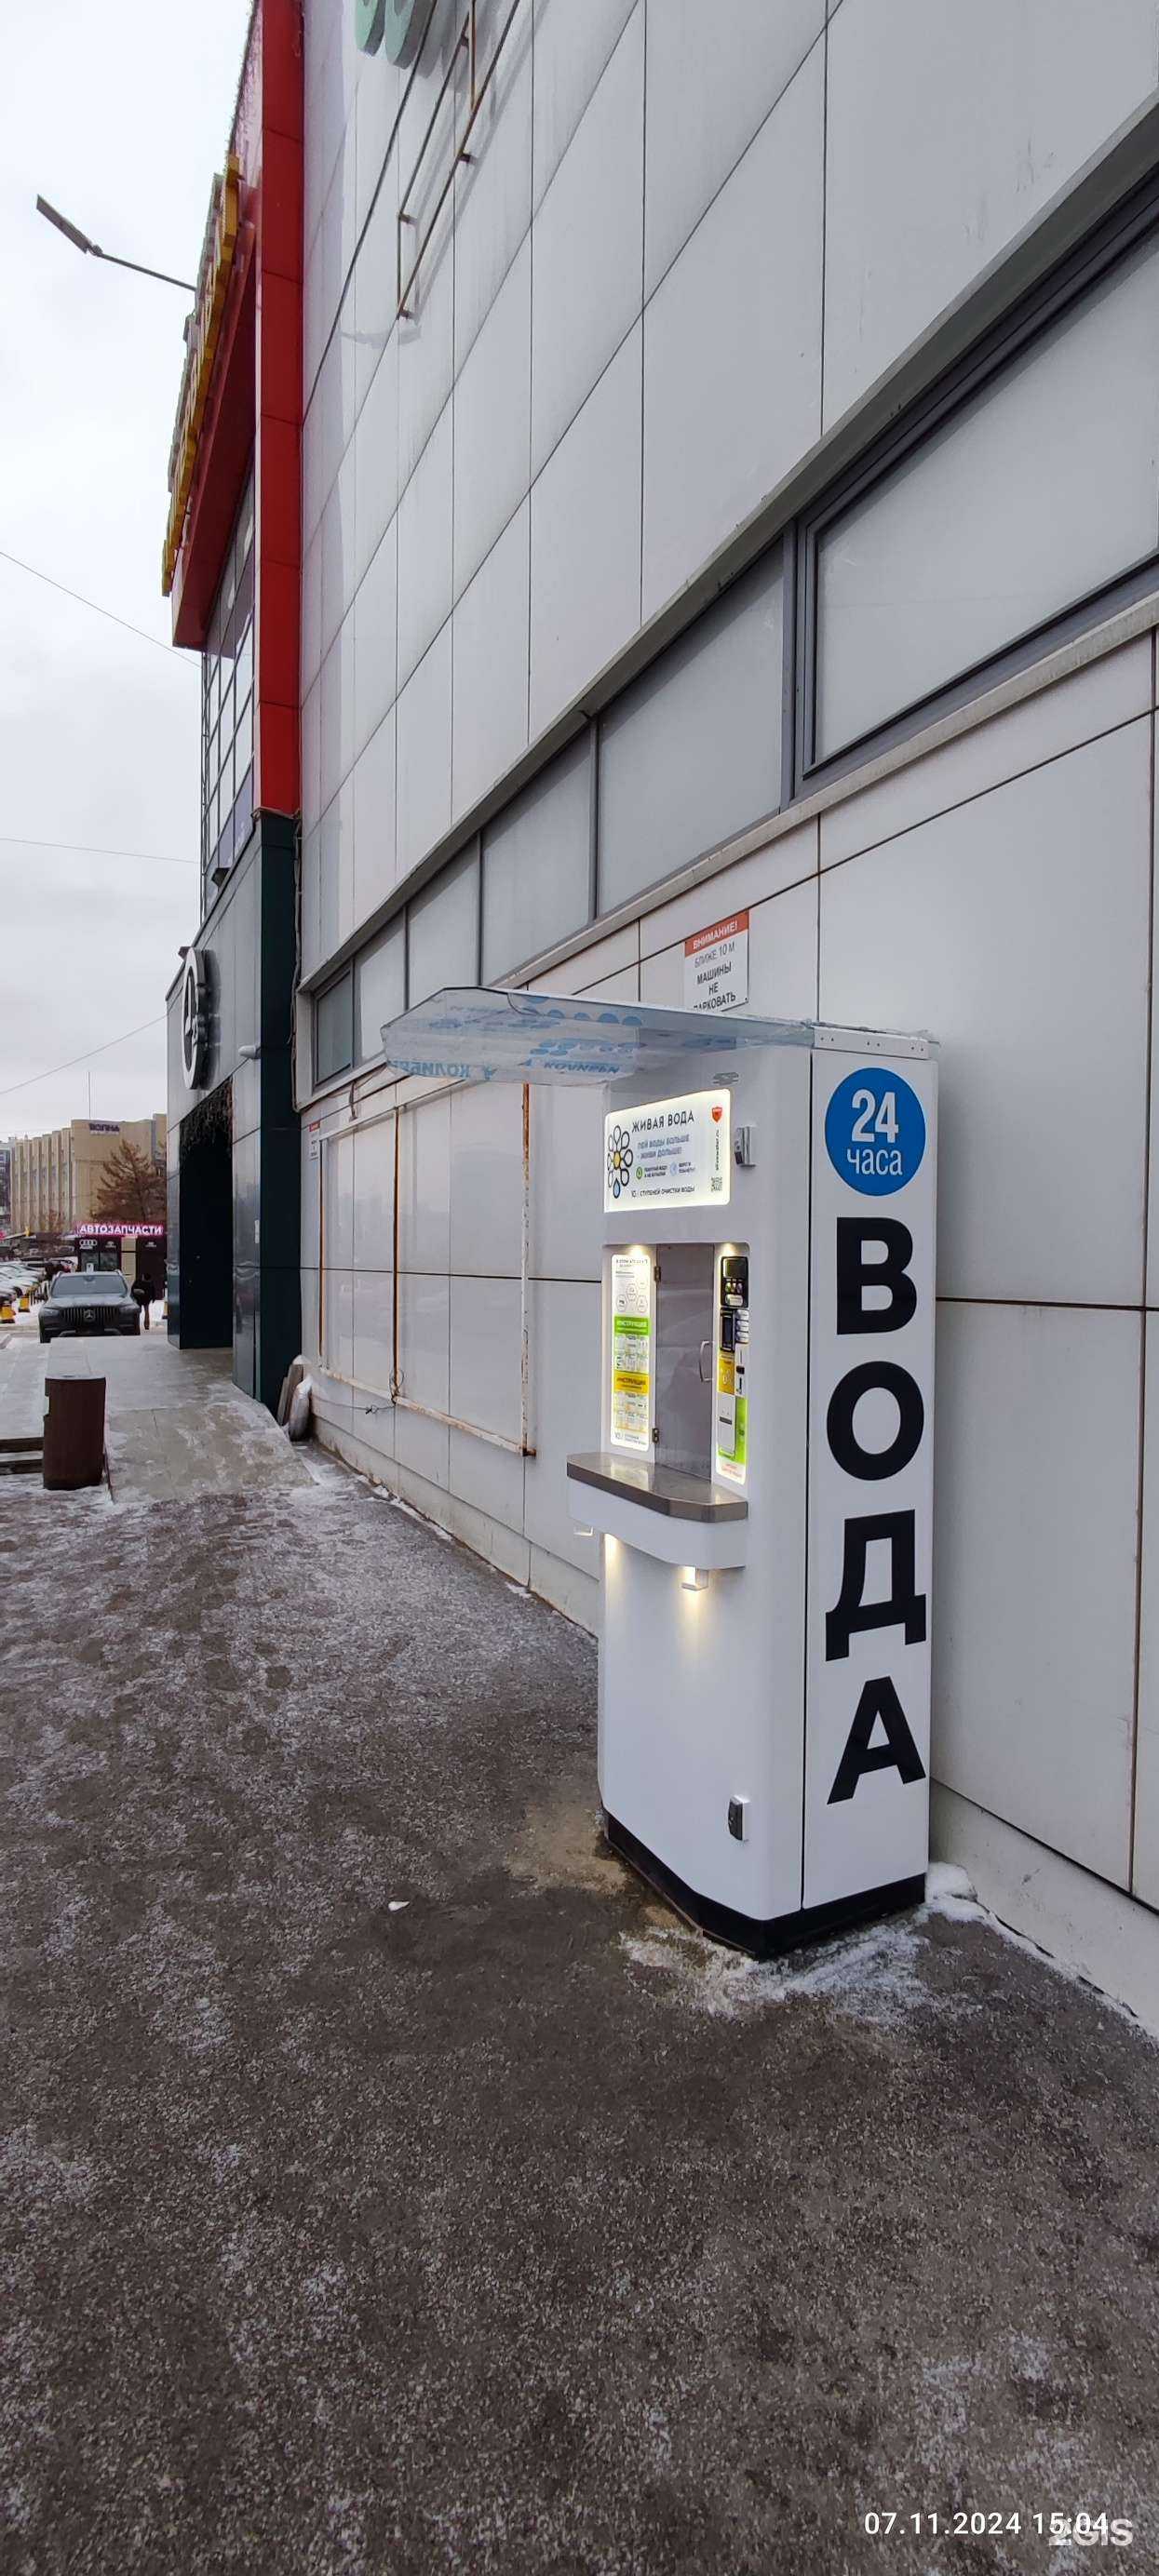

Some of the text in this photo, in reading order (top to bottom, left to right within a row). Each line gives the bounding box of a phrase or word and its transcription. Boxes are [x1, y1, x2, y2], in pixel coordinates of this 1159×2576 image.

[693, 920, 737, 949] ВНИМАНИЕ!
[694, 949, 717, 968] БЛИЖЕ
[720, 945, 727, 956] 10
[697, 961, 732, 985] МАШИНЫ
[708, 982, 719, 995] НЕ
[631, 1110, 694, 1133] ЖИВАЯ ВОДА
[851, 1089, 899, 1143] 24
[846, 1148, 903, 1175] часа
[79, 1224, 163, 1236] АВТОЗАПЧАСТИ
[825, 1216, 926, 1805] ВОДА
